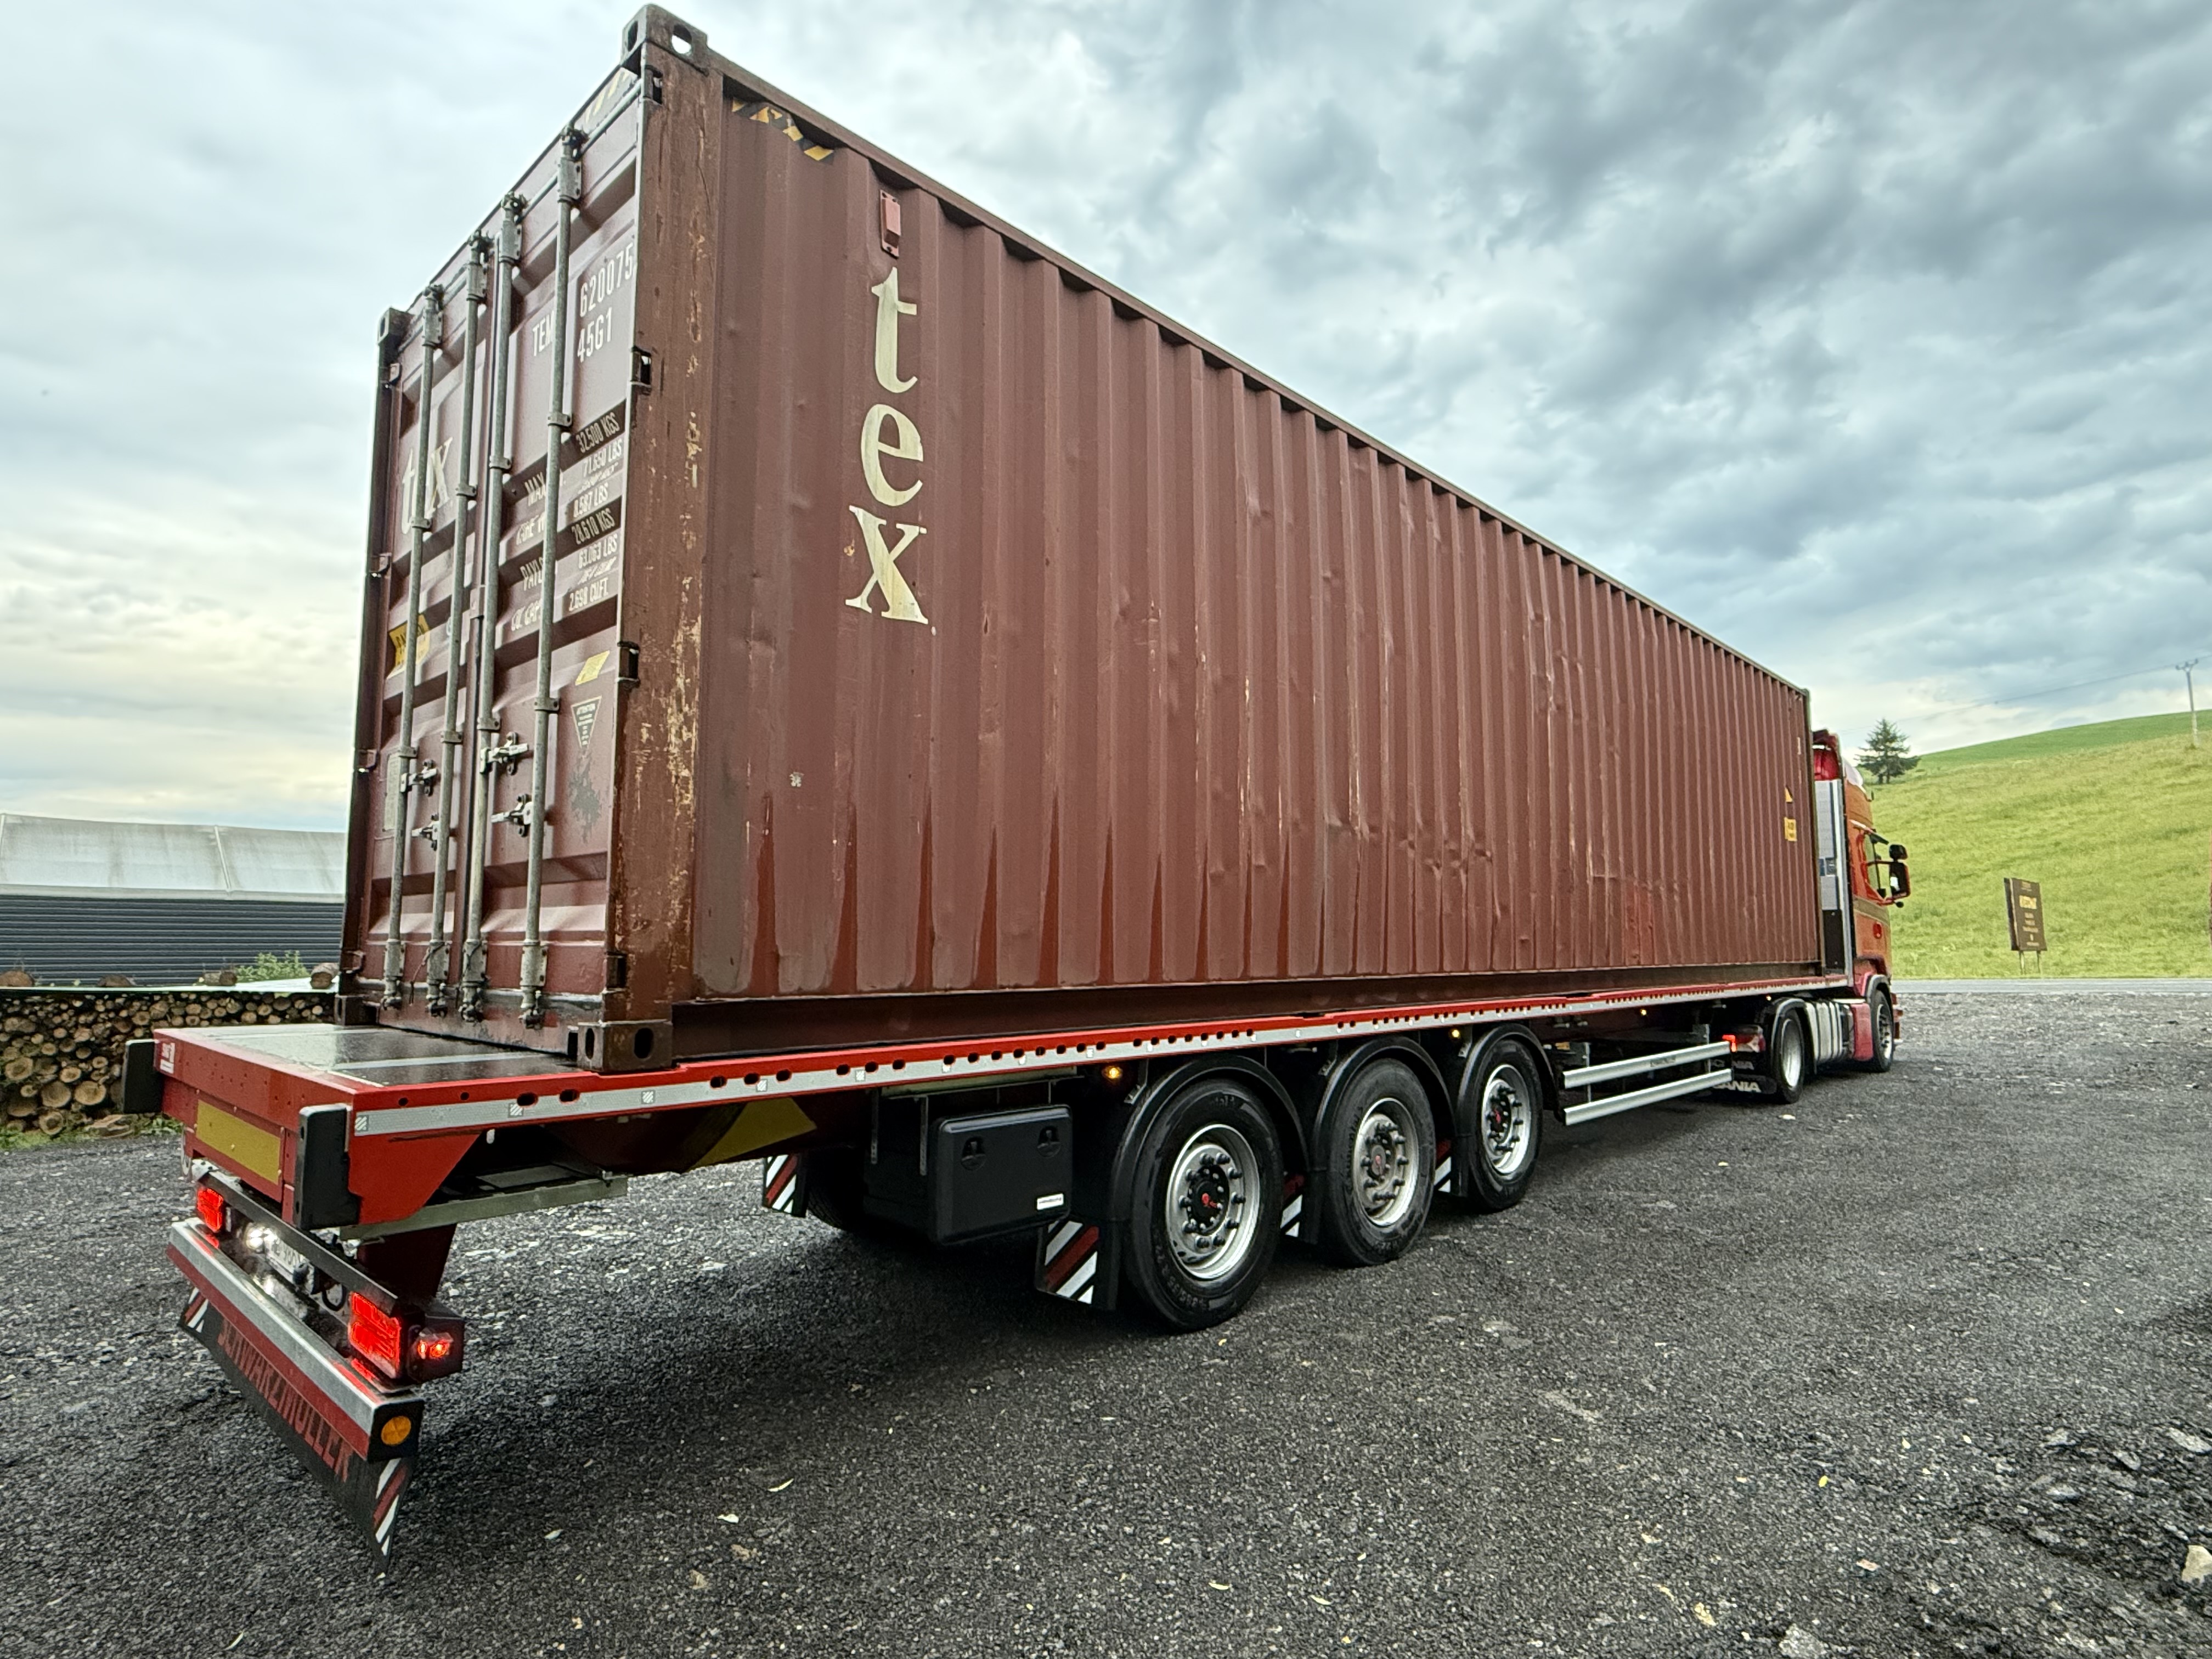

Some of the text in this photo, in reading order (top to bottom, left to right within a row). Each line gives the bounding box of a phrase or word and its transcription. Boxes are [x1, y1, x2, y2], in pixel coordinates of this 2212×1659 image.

[532, 242, 633, 357] TEM 620075
[577, 307, 613, 363] 45G1
[600, 411, 620, 437] KGS
[608, 438, 623, 462] LBS
[845, 267, 929, 625] tex
[594, 481, 609, 506] LBS
[595, 507, 616, 532] KGS
[603, 533, 618, 563] LBS
